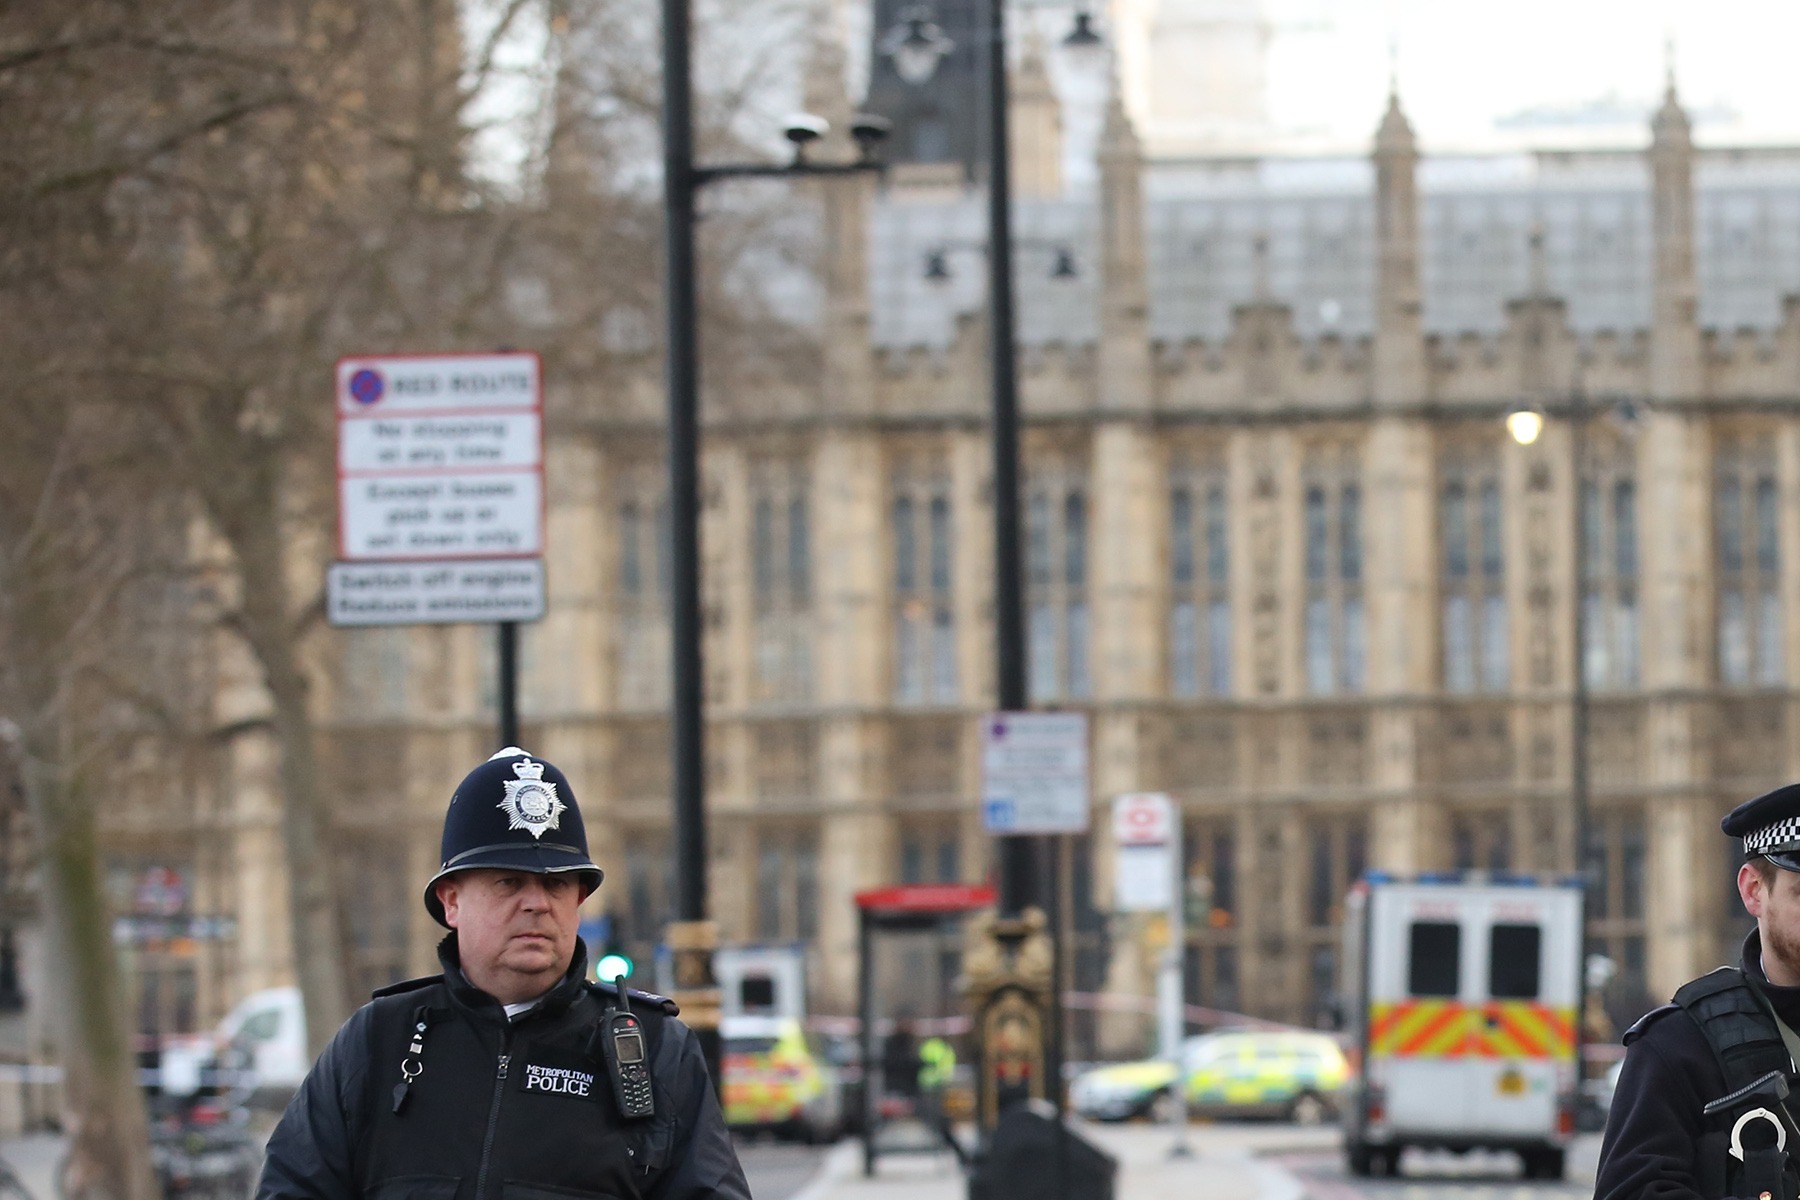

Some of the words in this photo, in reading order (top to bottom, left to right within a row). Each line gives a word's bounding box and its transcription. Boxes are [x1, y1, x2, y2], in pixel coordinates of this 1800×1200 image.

[393, 375, 438, 393] RED
[451, 374, 530, 392] ROUTE
[370, 422, 401, 437] No
[411, 420, 506, 440] stopping
[454, 445, 502, 460] time
[367, 482, 442, 501] Except
[450, 481, 515, 498] buses
[409, 530, 464, 547] down
[339, 570, 411, 590] Switch
[460, 570, 532, 590] engine
[339, 597, 417, 613] Reduce
[426, 595, 534, 612] emissions
[526, 1064, 594, 1083] METROPOLITAN
[526, 1074, 590, 1096] POLICE
